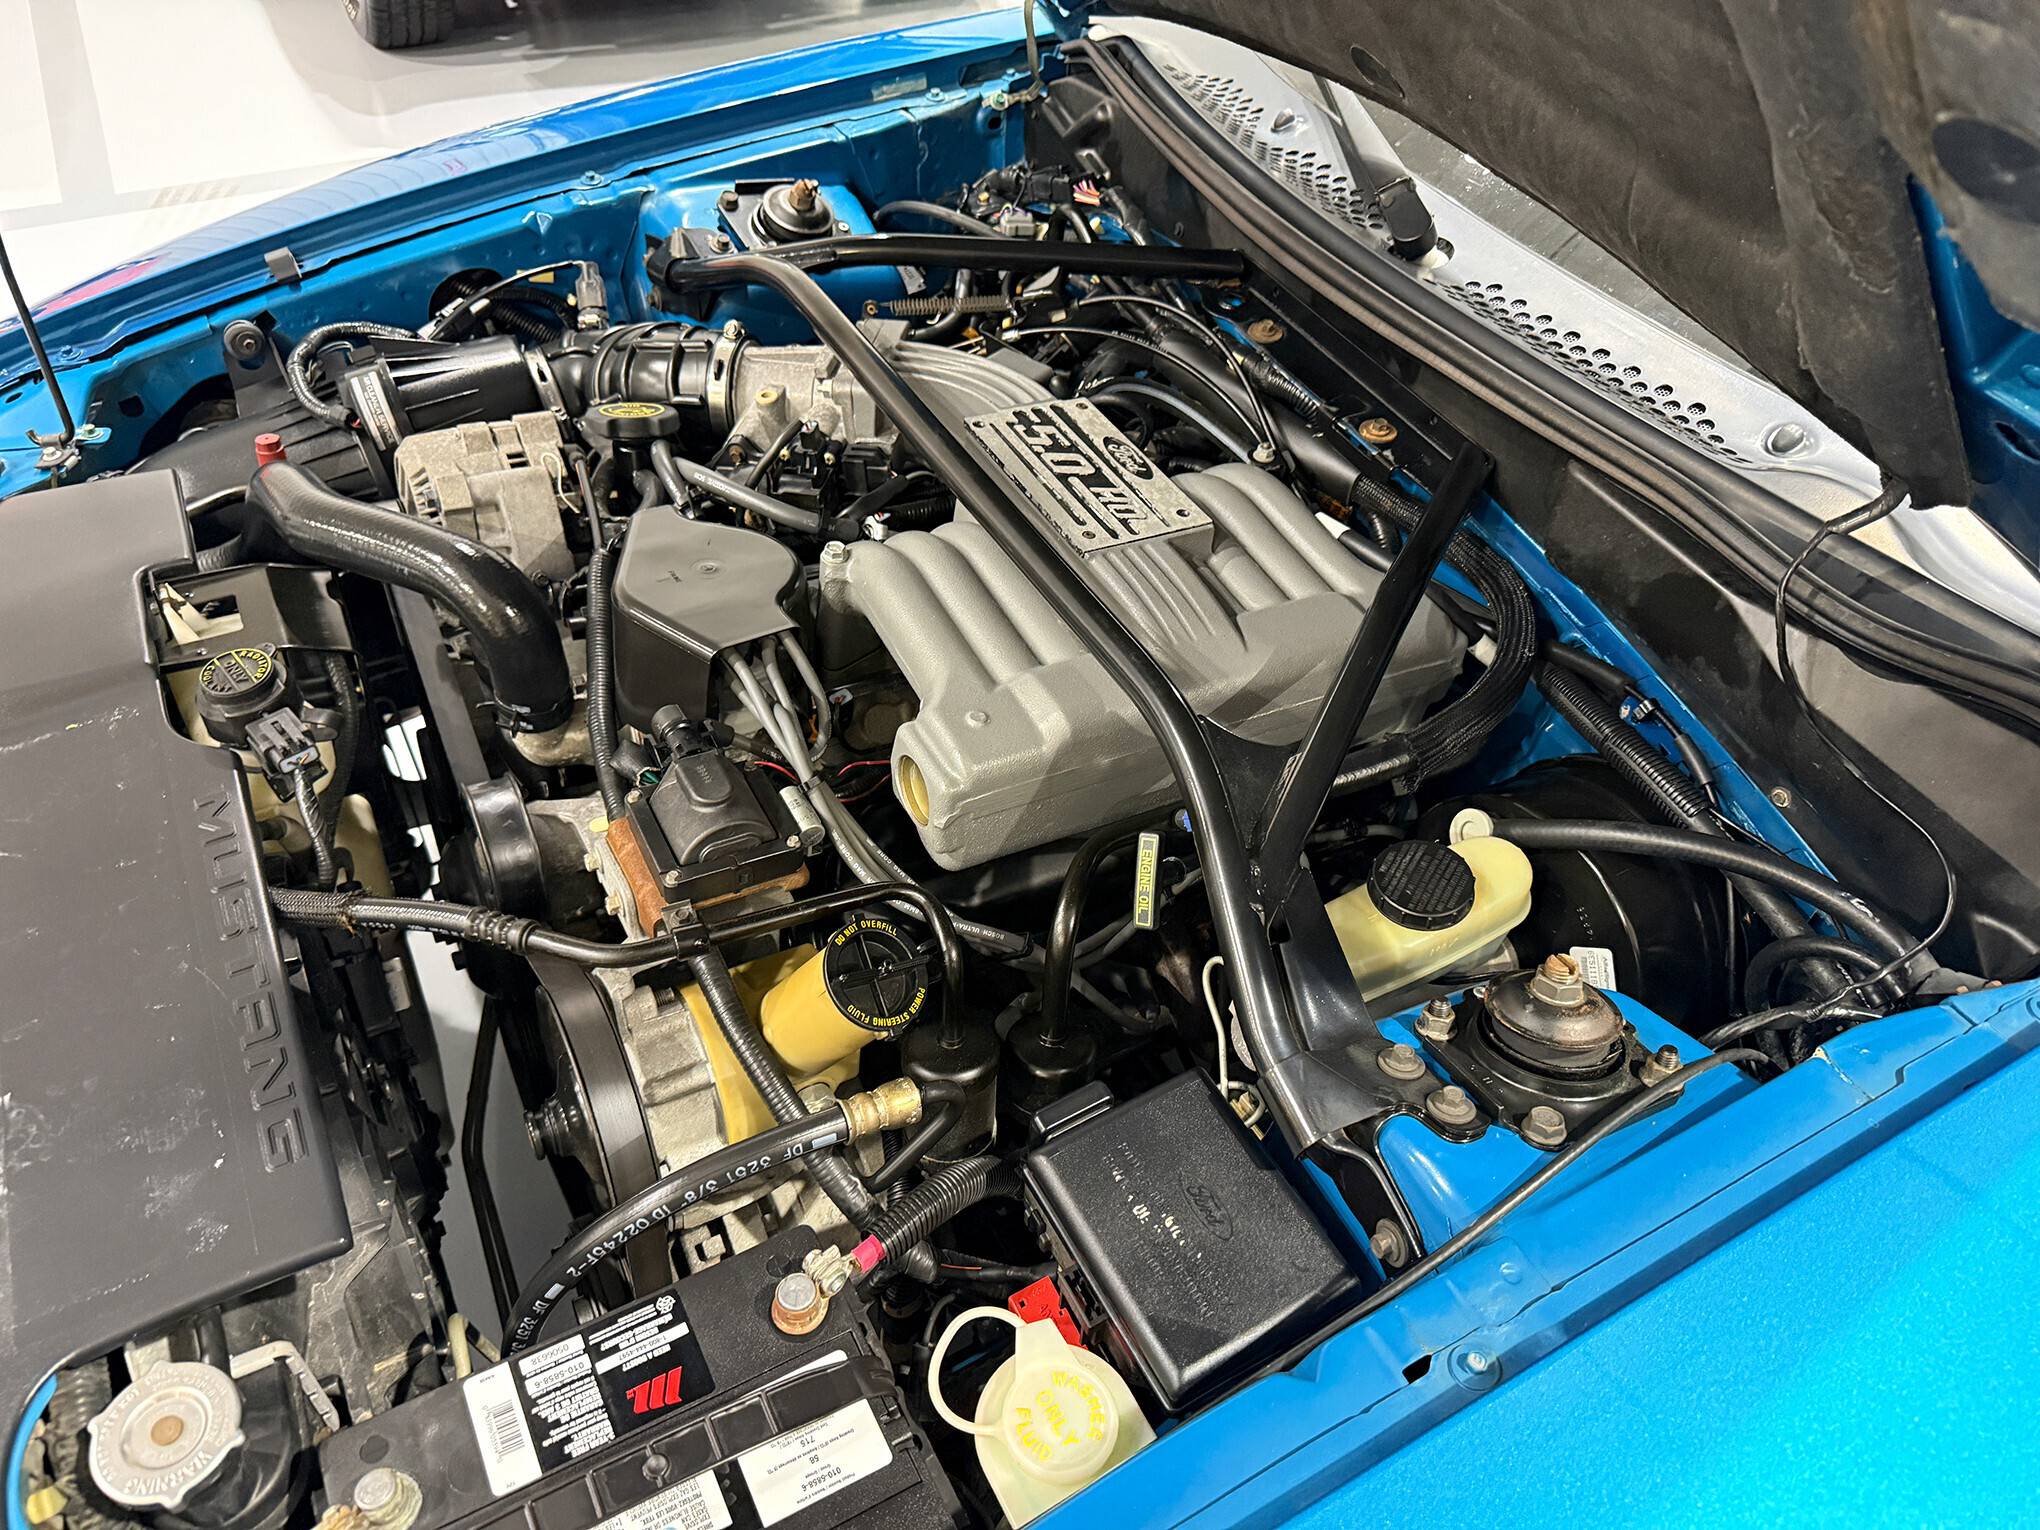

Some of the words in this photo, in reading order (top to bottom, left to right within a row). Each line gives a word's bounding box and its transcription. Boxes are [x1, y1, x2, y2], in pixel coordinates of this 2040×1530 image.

[365, 385, 382, 415] CLEANER
[377, 413, 395, 444] SERVICE
[1108, 441, 1149, 475] Ford
[202, 664, 233, 692] COOLANT
[223, 660, 250, 684] ONLY
[239, 649, 268, 680] RADIATOR
[853, 862, 866, 877] MAG
[1141, 848, 1151, 893] ENGINE
[1139, 895, 1148, 913] OIL
[834, 934, 844, 946] DO
[844, 922, 858, 936] NOT
[860, 919, 897, 936] OVERFILL
[983, 929, 1005, 940] BOSCH
[193, 785, 309, 1173] MUSTANG
[846, 1004, 870, 1023] FLUID
[908, 986, 926, 1014] POWER
[872, 1011, 910, 1026] STEERING
[782, 1142, 804, 1161] DF
[726, 1155, 772, 1184] 3251
[652, 1204, 671, 1221] ID
[566, 1217, 649, 1277] 02245F-2
[532, 1300, 550, 1316] DF
[515, 1317, 539, 1340] 3251
[534, 1361, 585, 1388] 010-5858-6
[1035, 1388, 1081, 1446] ONLY
[1051, 1370, 1105, 1441] WASHER
[799, 1434, 815, 1447] 715
[1014, 1406, 1052, 1462] FLUID
[124, 1449, 214, 1495] WARNING
[808, 1453, 820, 1464] 58
[800, 1466, 841, 1491] 010-5858-6
